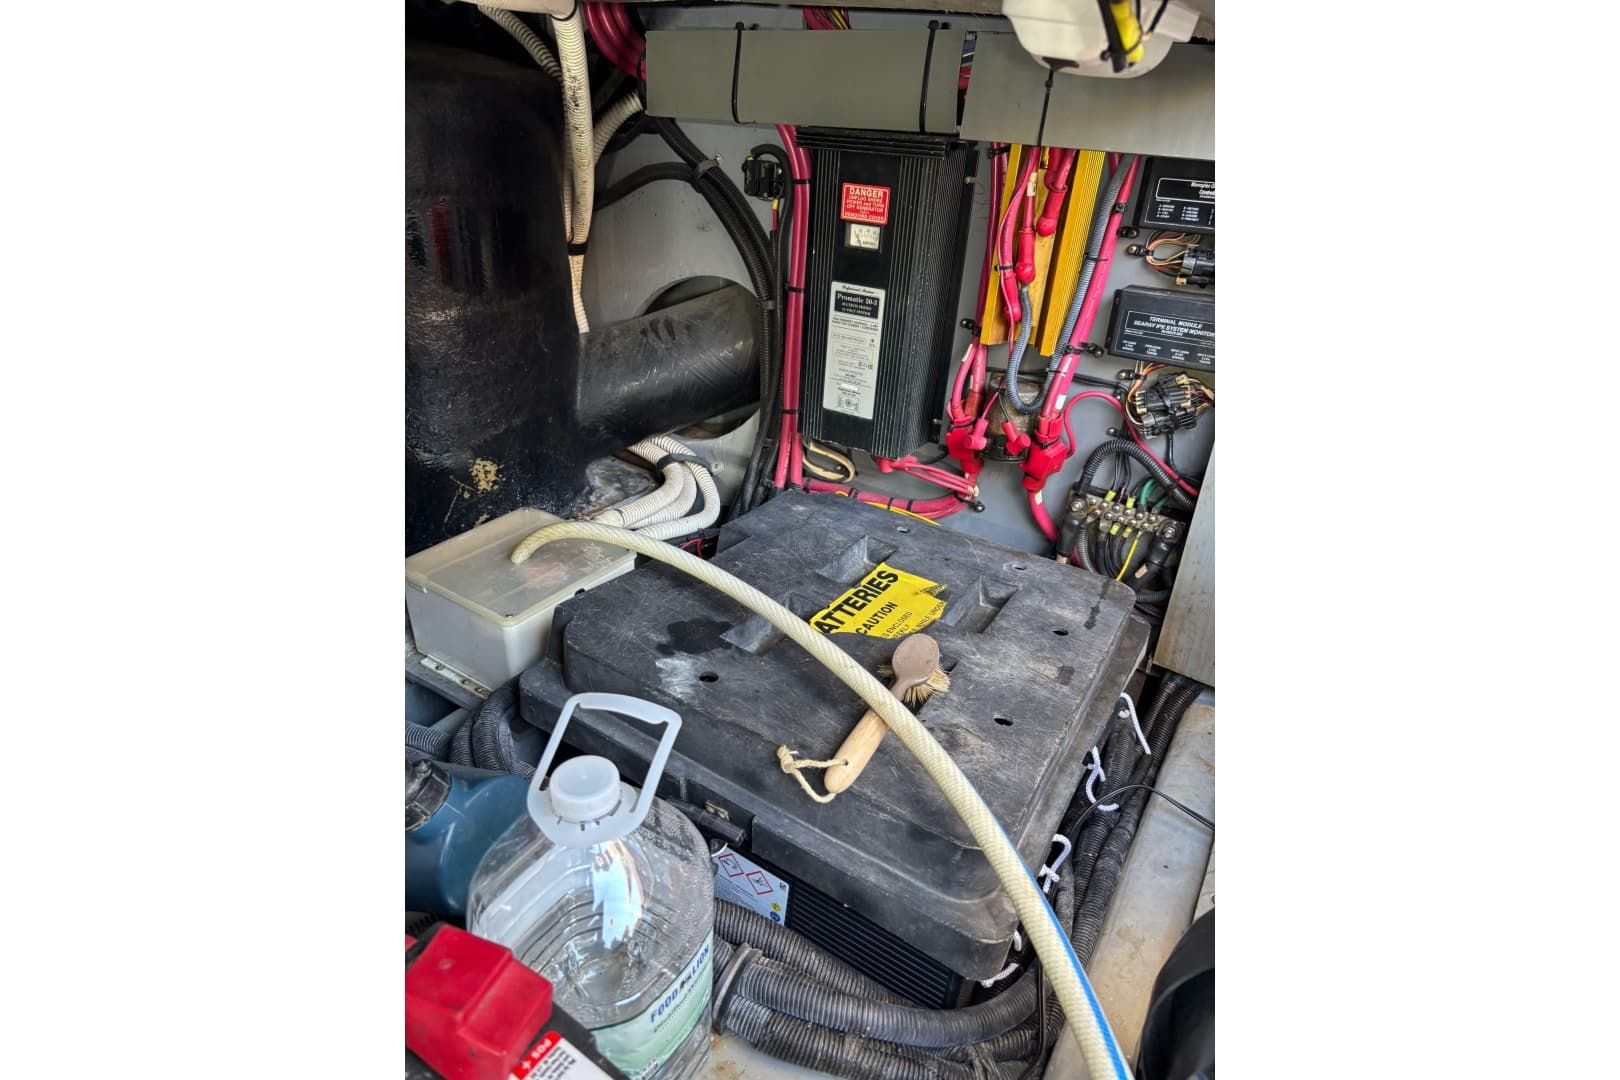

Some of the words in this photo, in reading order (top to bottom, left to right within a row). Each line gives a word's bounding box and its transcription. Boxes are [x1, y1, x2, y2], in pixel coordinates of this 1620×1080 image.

[849, 187, 883, 199] DANGER
[837, 291, 865, 304] Promatic
[1150, 316, 1176, 326] TERMINAL
[1178, 320, 1203, 329] MODULE
[1166, 325, 1188, 334] SYSTEM
[814, 570, 899, 634] ATTERIES
[856, 601, 899, 635] CAUTION
[650, 988, 679, 1023] FOOD
[691, 943, 710, 975] LION
[530, 1037, 553, 1059] POS
